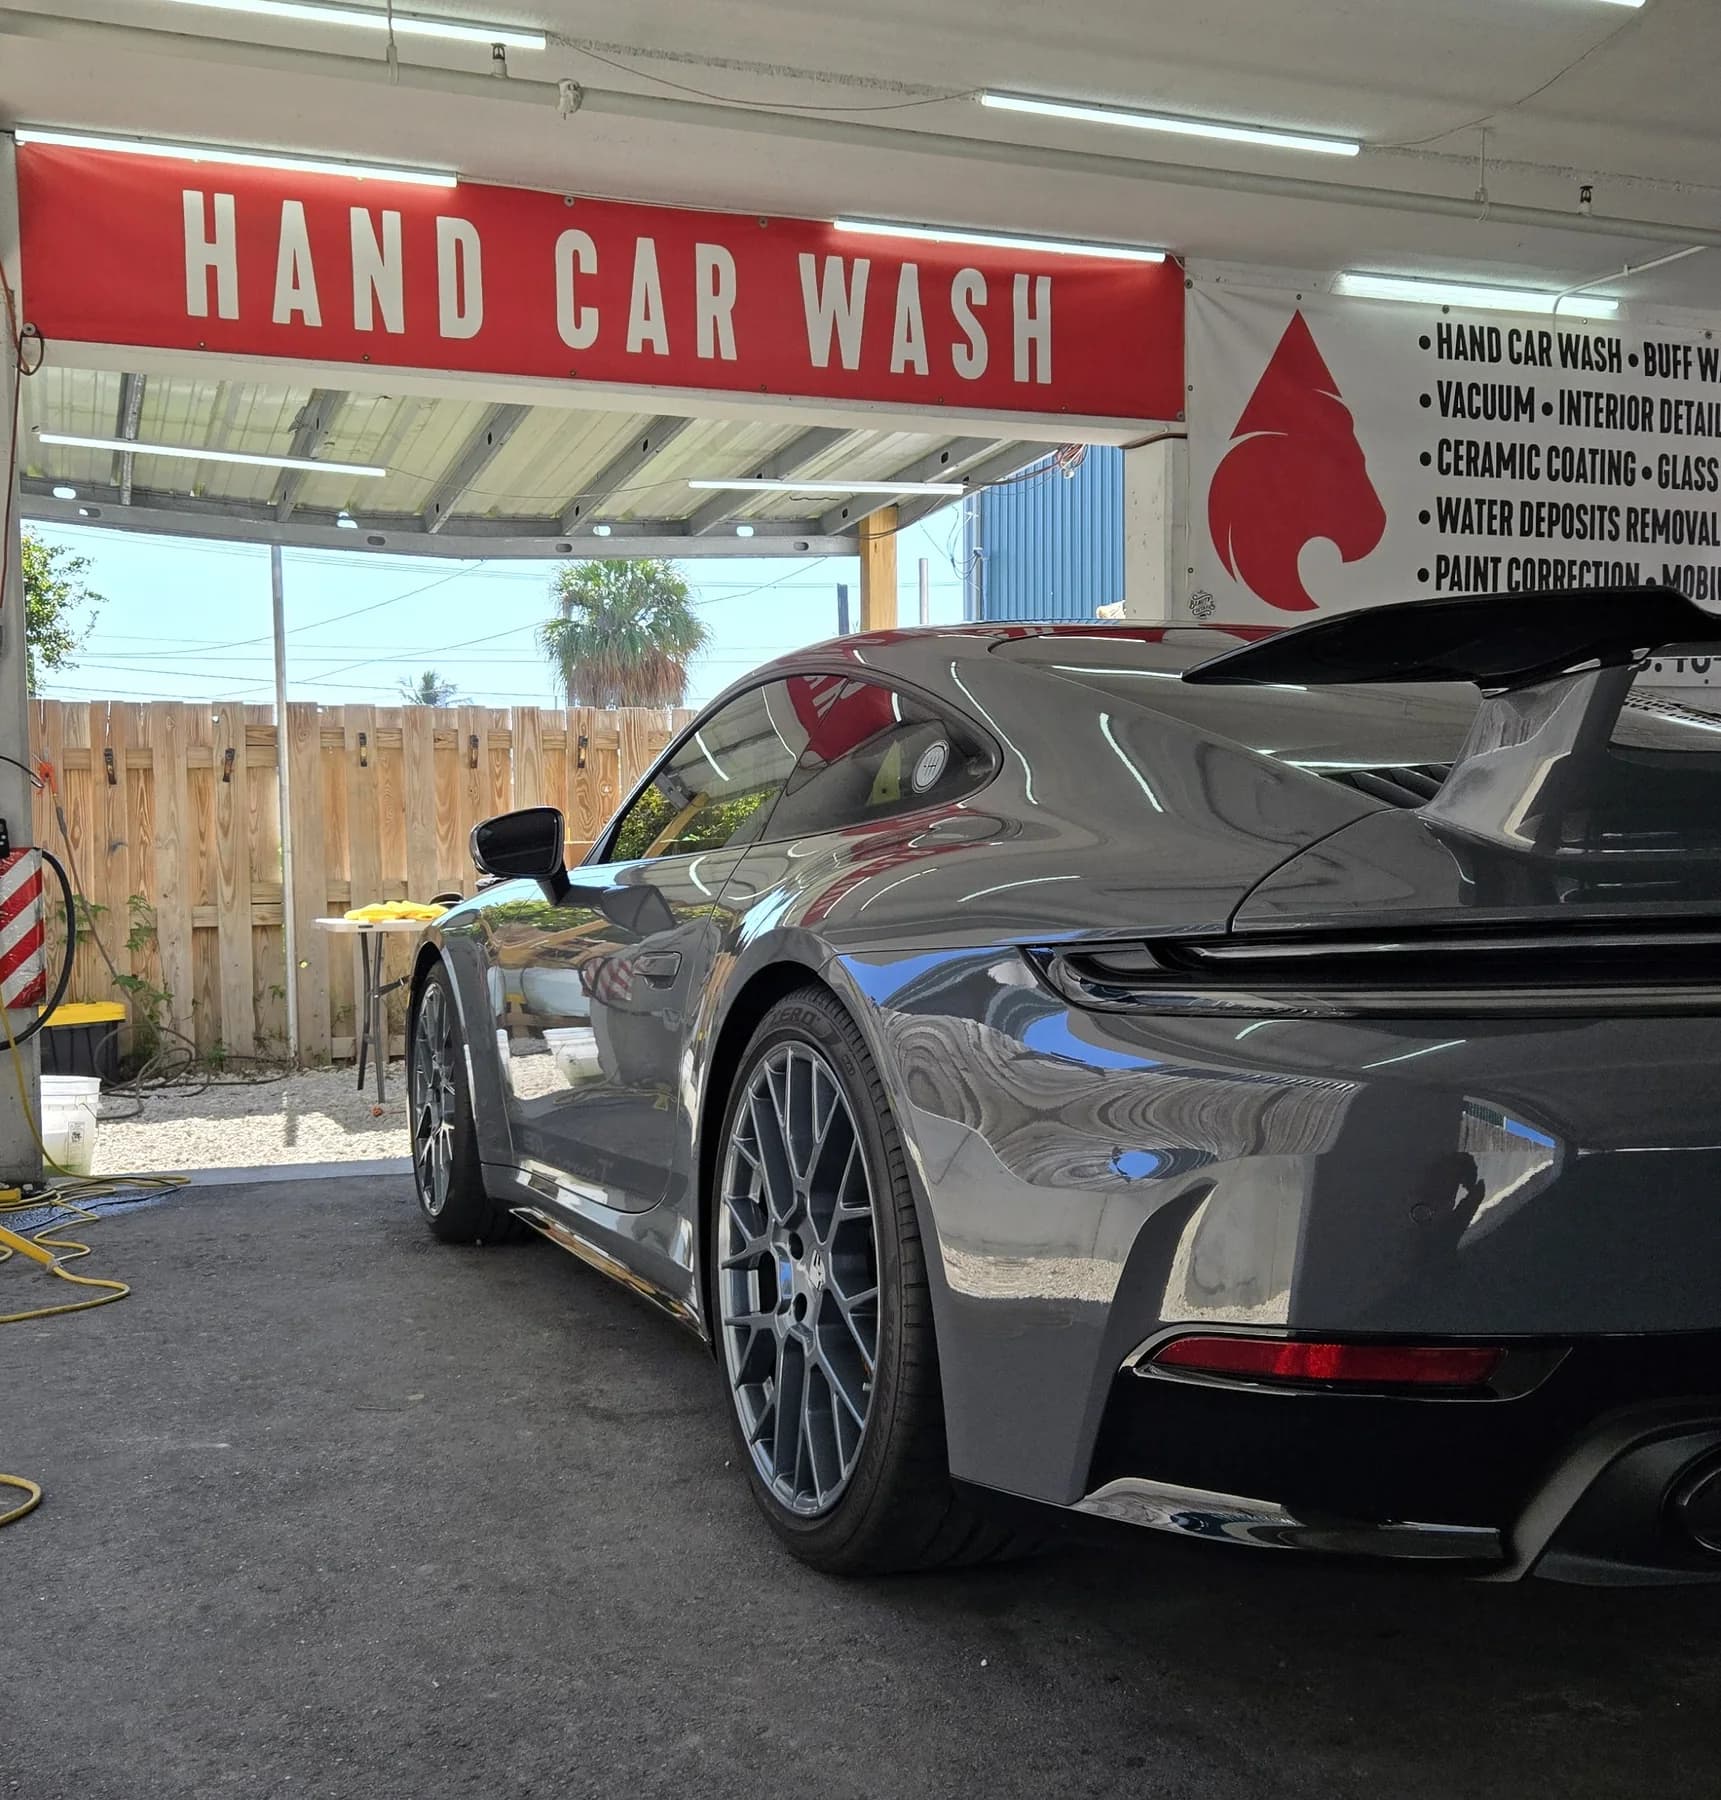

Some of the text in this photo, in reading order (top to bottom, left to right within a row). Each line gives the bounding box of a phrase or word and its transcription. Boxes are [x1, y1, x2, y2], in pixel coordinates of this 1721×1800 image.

[183, 190, 1052, 384] HAND CAR WASH
[1437, 323, 1721, 383] HAND CAR WASH BUFF W
[1437, 380, 1721, 437] VACUUM INTERIOR DETAIL
[1438, 439, 1719, 492] CERAMIC COATING GLASS
[1437, 497, 1720, 546] WATER DEPOSITS REMOVAL
[1436, 555, 1502, 592] PAINT
[1507, 558, 1639, 592] CORRECTION
